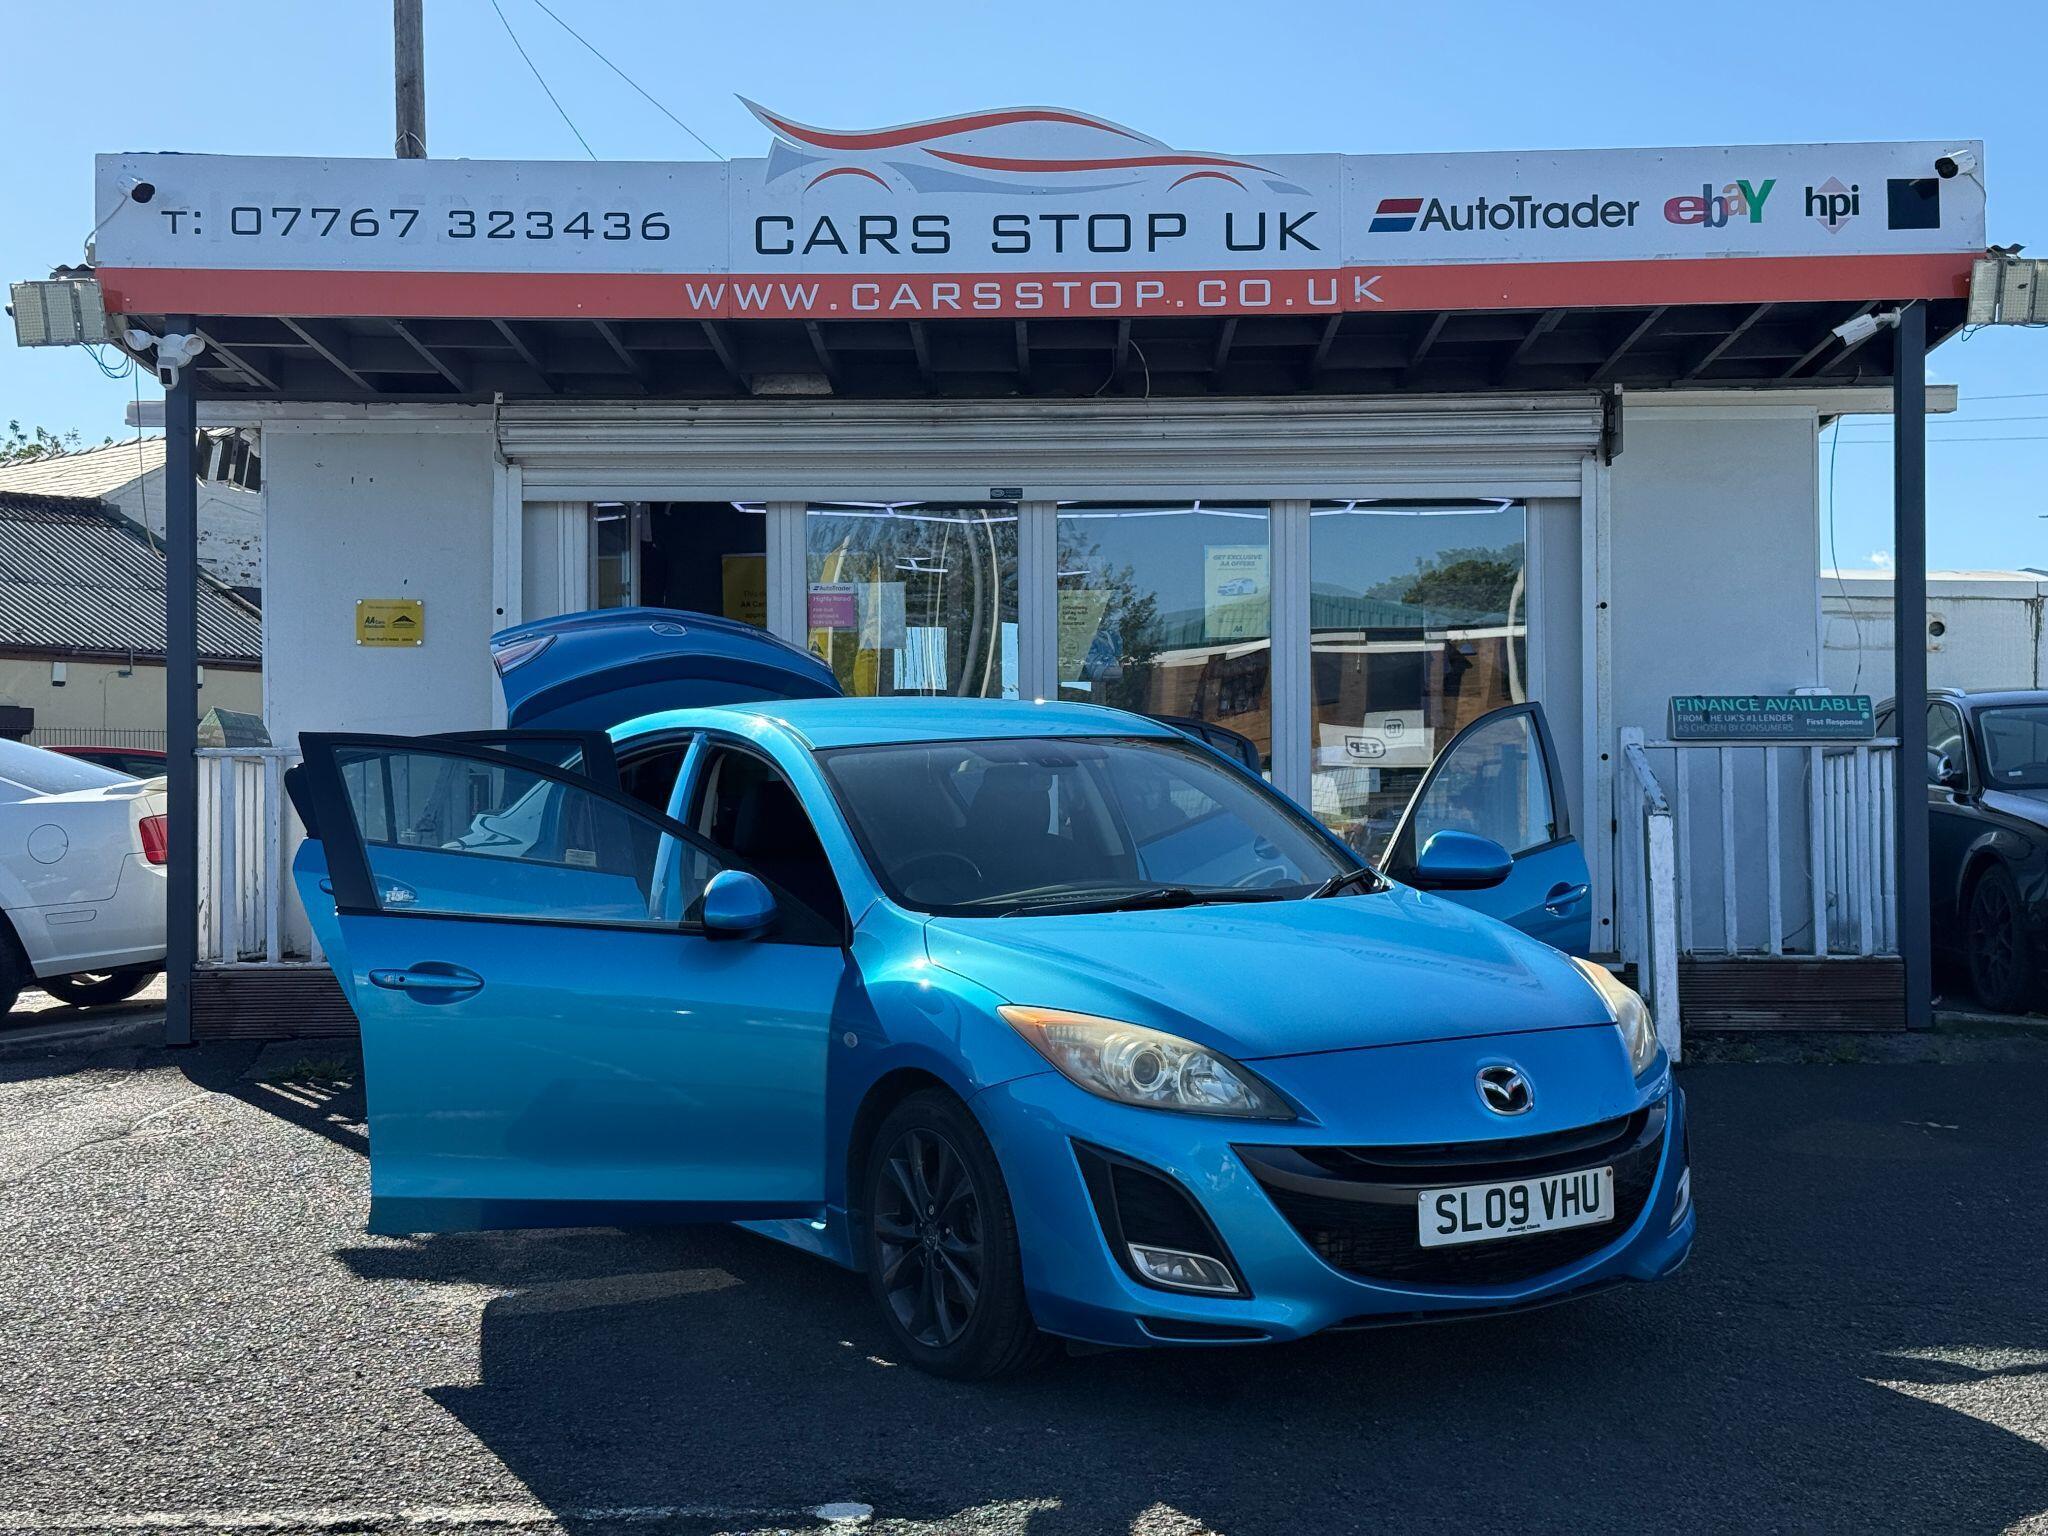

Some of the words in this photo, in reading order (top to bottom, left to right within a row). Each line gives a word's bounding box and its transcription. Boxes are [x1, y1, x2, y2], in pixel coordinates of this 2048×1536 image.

[1419, 194, 1640, 232] AutoTrader
[1805, 184, 1860, 225] hpi
[161, 210, 202, 235] T:
[231, 206, 420, 239] 07767
[447, 208, 671, 241] 323436
[754, 215, 952, 255] CARS
[992, 212, 1187, 253] STOP
[1225, 211, 1321, 252] UK
[685, 274, 1384, 315] WWW.CARSSTOP.CO.UK
[1675, 698, 1761, 712] FINANCE
[1764, 697, 1869, 712] AVAILABLE
[1677, 714, 1703, 722] FROM
[1724, 714, 1745, 722] UK'S
[1758, 714, 1794, 722] LENDER
[1806, 718, 1824, 726] First
[1825, 718, 1864, 727] Response
[1690, 724, 1727, 732] CHOSEN
[1739, 723, 1794, 732] CONSUMERS
[1435, 1184, 1530, 1235] SL09
[1540, 1173, 1600, 1221] VHU
